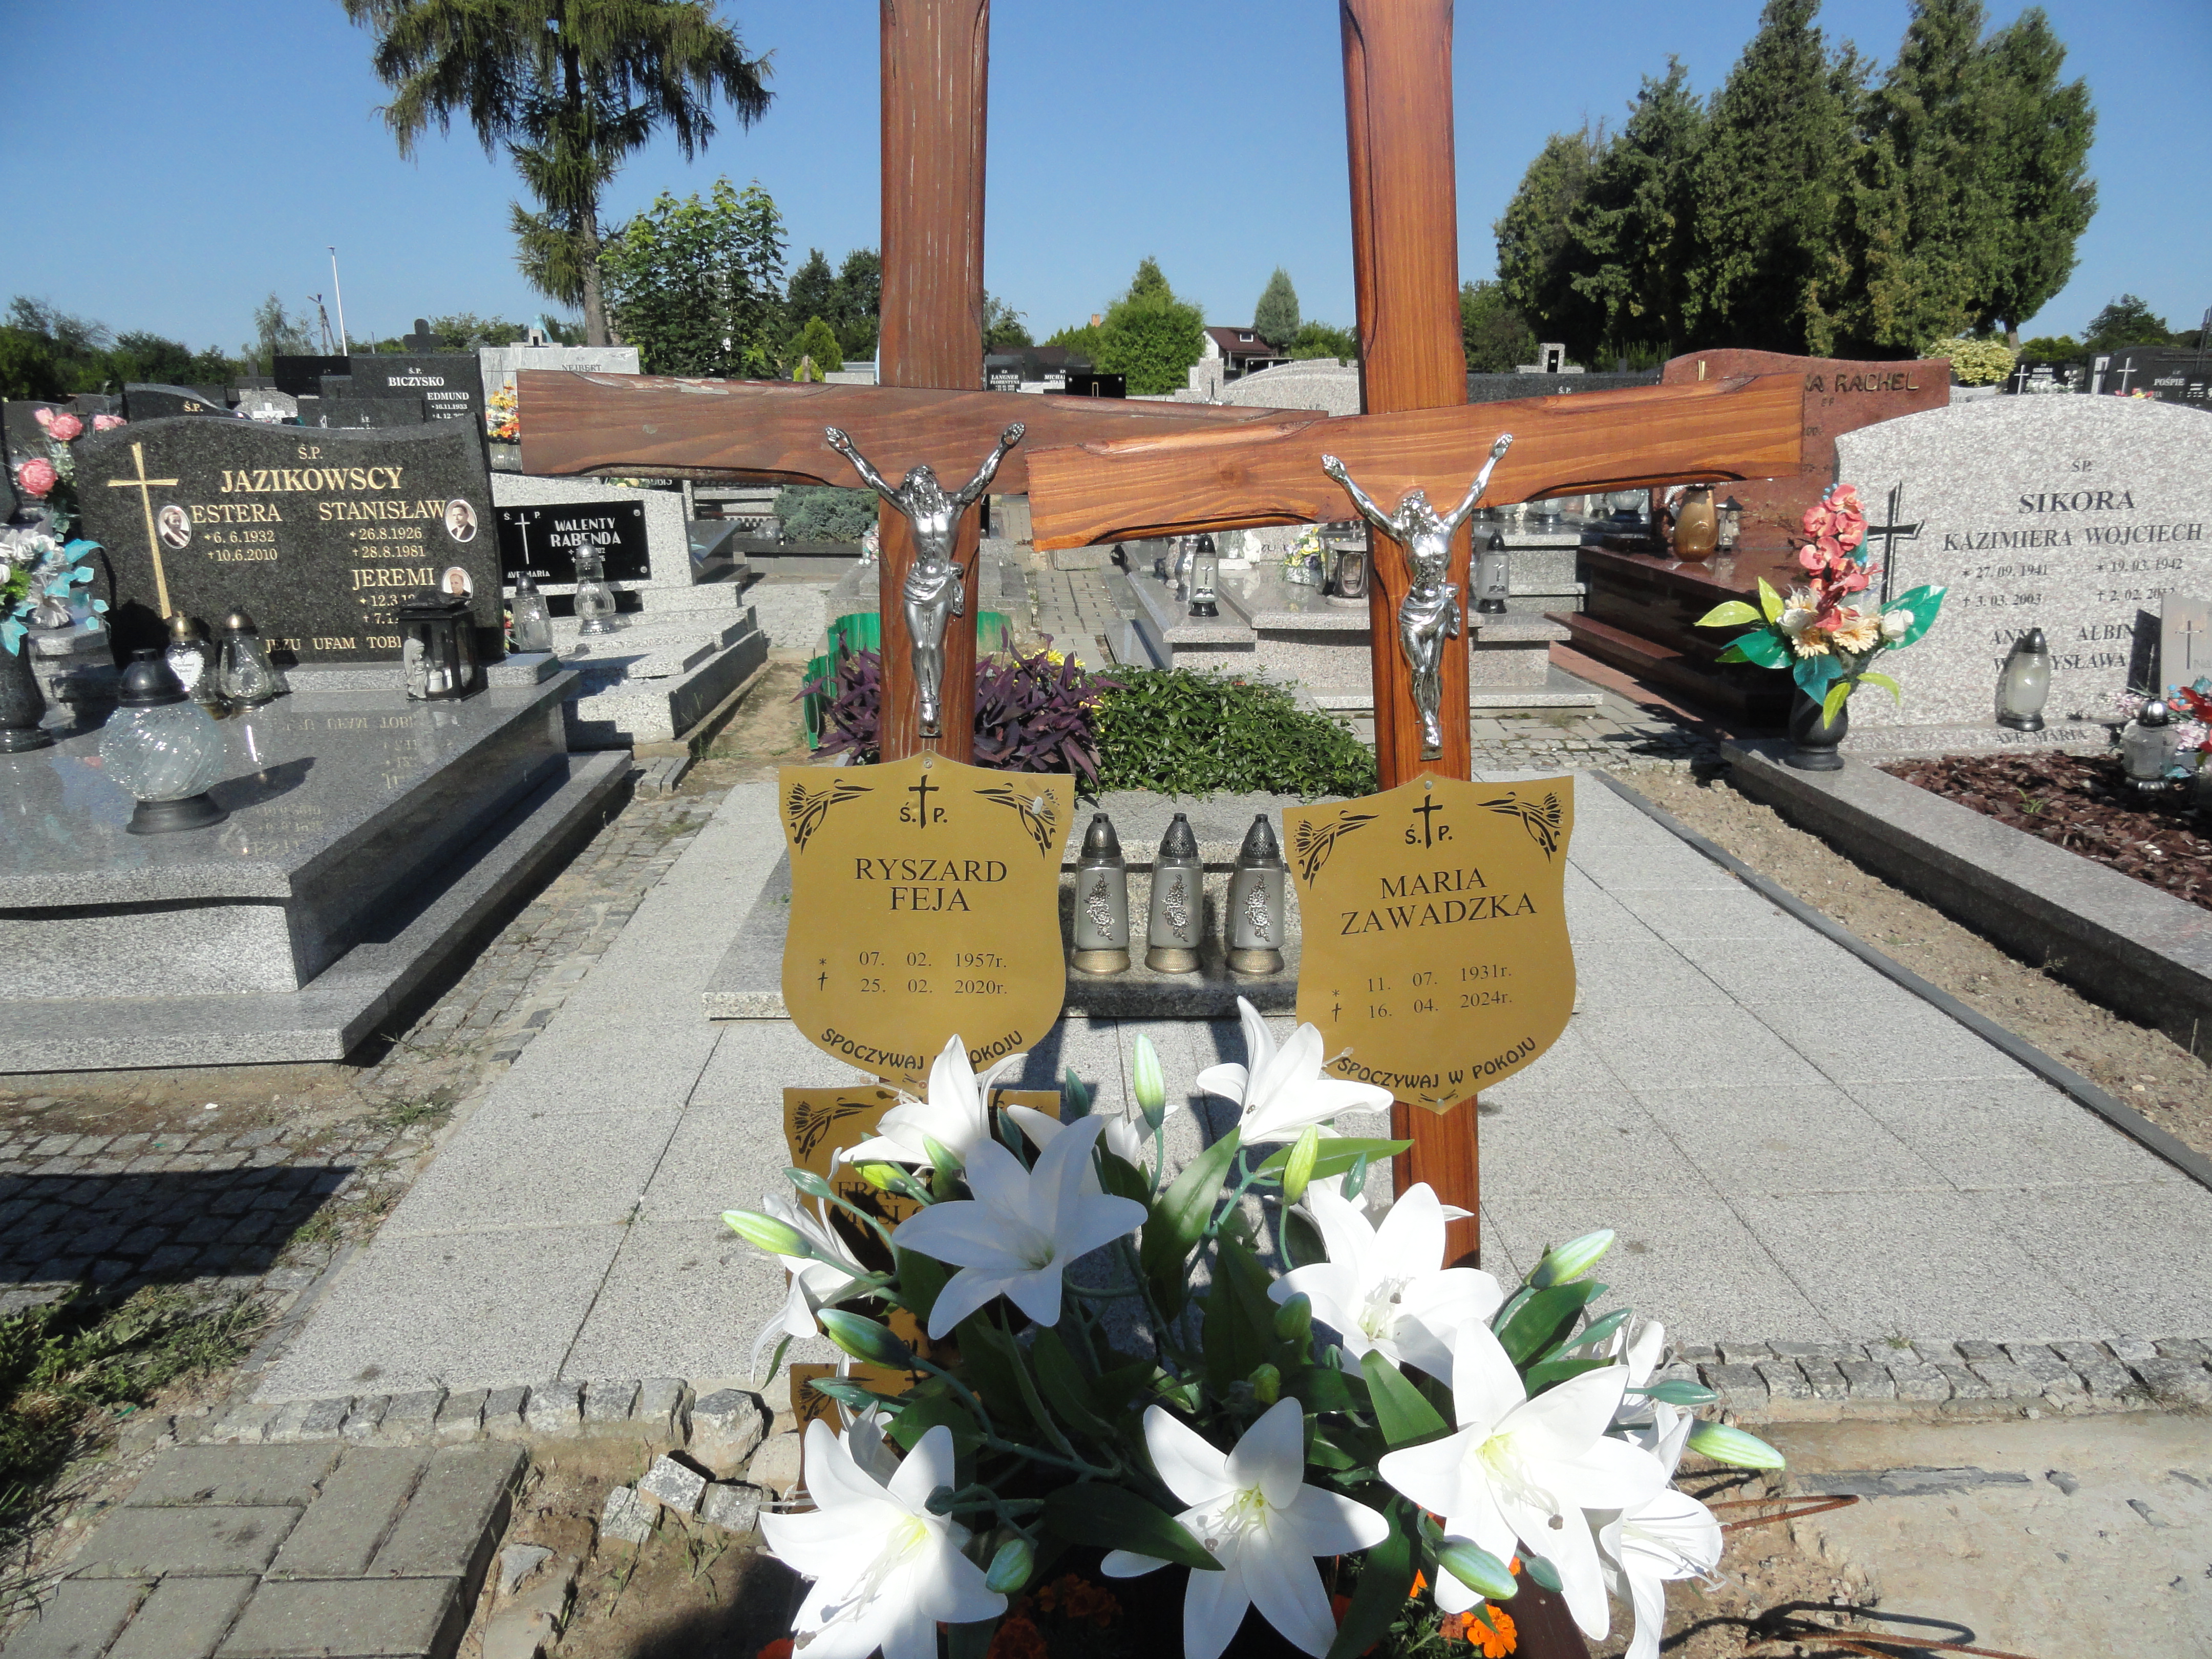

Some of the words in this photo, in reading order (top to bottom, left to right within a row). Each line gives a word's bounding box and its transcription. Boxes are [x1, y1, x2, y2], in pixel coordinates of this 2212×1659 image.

[388, 376, 444, 387] BICZYSKO
[1835, 372, 1919, 392] RACHEL
[2154, 376, 2185, 386] POŚPIE
[427, 392, 469, 400] EDMUND
[221, 467, 403, 494] JAZIKOWSCY
[190, 503, 283, 524] ESTERA
[319, 500, 446, 521] STANISŁAW
[2018, 491, 2135, 514] SIKORA
[359, 527, 422, 540] 26.8.1926
[555, 518, 615, 531] WALENTY
[550, 531, 622, 547] RABENDA
[1943, 529, 2073, 551] KAZIMIERA
[2085, 522, 2203, 546] WOJCIECH
[217, 548, 278, 562] 10.6.2010
[361, 545, 426, 559] 28.8.1981
[2021, 564, 2048, 576] 1941
[2155, 558, 2182, 570] 1942
[352, 568, 435, 590] JEREMI
[2013, 593, 2041, 605] 2003
[265, 638, 301, 653] JEZU
[313, 636, 356, 650] UFAM
[367, 636, 402, 649] TOBI
[1989, 629, 2030, 645] ANN
[1996, 732, 2026, 744] AVE
[2034, 729, 2087, 742] MARIA
[900, 801, 917, 823] Ś.
[933, 807, 948, 823] P.
[1406, 824, 1421, 845] Ś.
[1438, 825, 1452, 841] P.
[855, 858, 1008, 882] RYSZARD
[1379, 867, 1487, 899] MARIA
[889, 886, 971, 912] FEJA
[1340, 893, 1537, 935] ZAWADZKA
[859, 951, 885, 967] 07.
[907, 952, 932, 967] 02.
[955, 952, 1007, 969] 1957r.
[860, 977, 886, 993] 25.
[908, 978, 933, 994] 02.
[954, 979, 1008, 995] 2020r.
[1367, 977, 1391, 992] 11.
[1412, 971, 1437, 987] 07.
[1460, 965, 1512, 982] 1931r.
[1370, 1004, 1392, 1019] 16.
[1414, 998, 1438, 1014] 04.
[1460, 990, 1512, 1009] 2024r.
[821, 1028, 924, 1070] SPOCZYWAJ
[1337, 1057, 1438, 1089] SPOCZYWAJ
[1449, 1070, 1463, 1085] W
[1472, 1036, 1536, 1079] POKOJU
